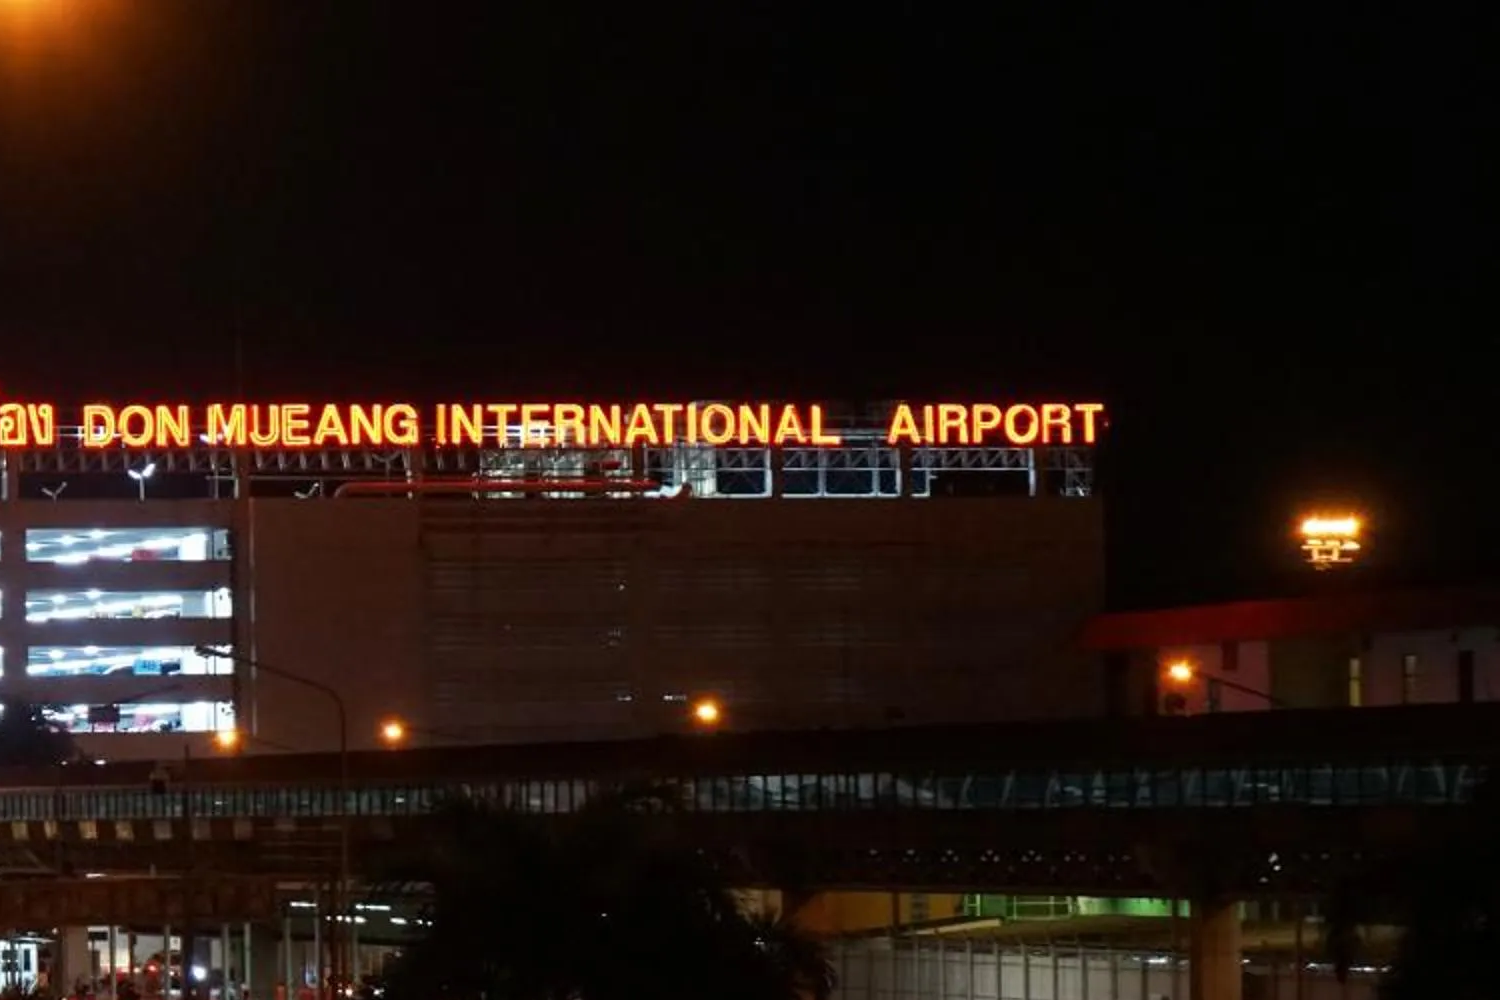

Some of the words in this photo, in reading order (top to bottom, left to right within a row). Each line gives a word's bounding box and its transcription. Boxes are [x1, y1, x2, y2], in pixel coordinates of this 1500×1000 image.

[83, 404, 189, 447] DON
[205, 403, 419, 446] MUEANG
[436, 402, 840, 447] INTERNATIONAL
[888, 403, 1104, 444] AIRPORT
